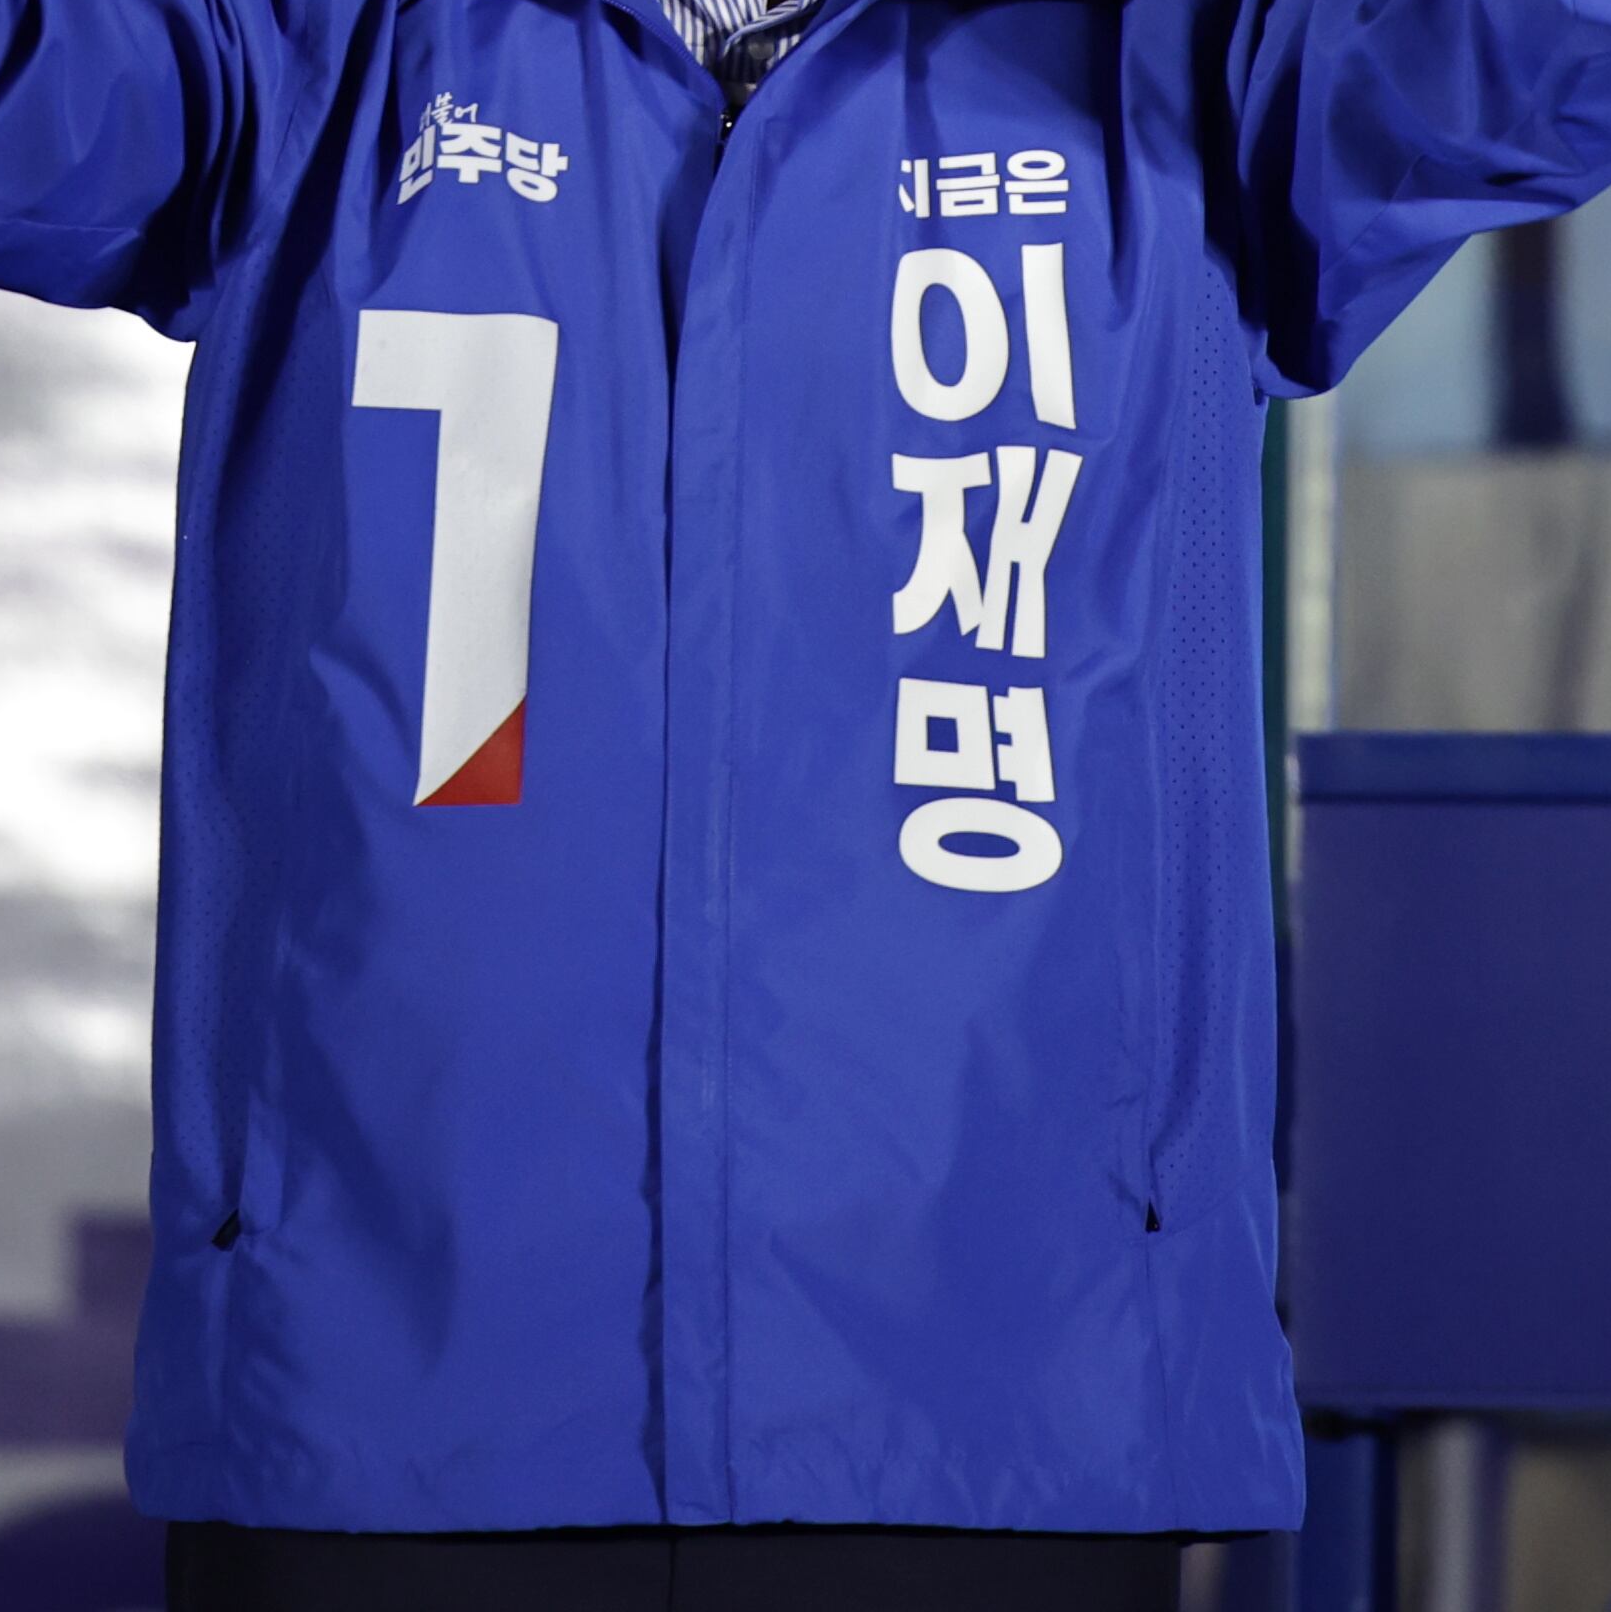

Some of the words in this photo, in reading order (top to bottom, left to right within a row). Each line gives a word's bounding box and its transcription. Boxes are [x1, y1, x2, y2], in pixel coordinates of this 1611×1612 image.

[397, 123, 569, 205] 민주당
[898, 149, 1069, 218] 지금은
[351, 308, 559, 807] 1
[891, 243, 1083, 893] 이재명
